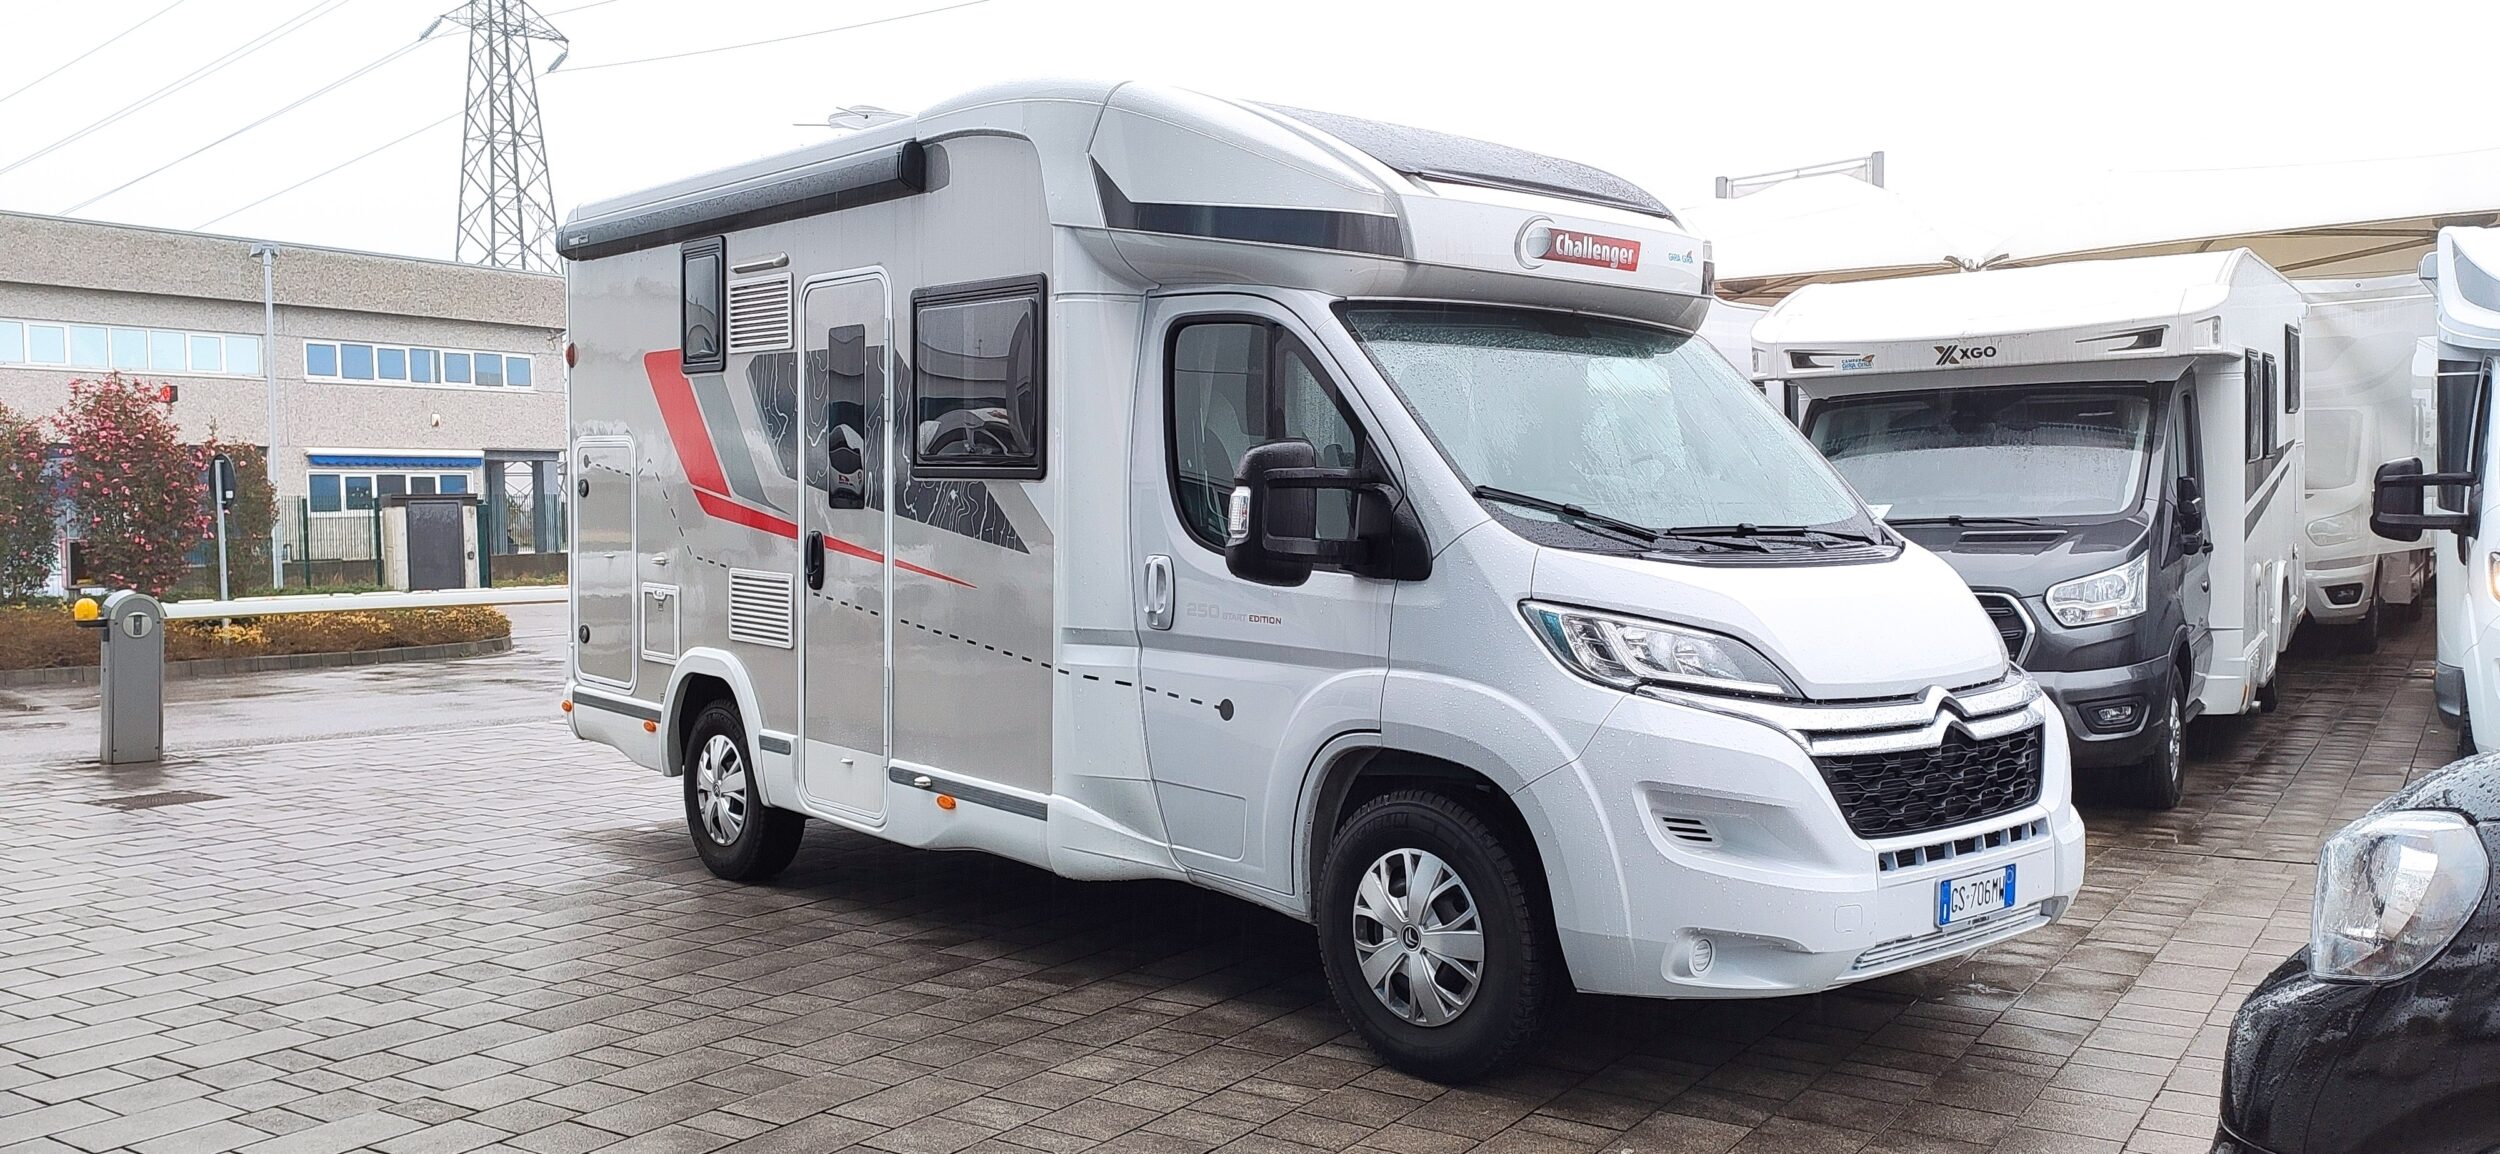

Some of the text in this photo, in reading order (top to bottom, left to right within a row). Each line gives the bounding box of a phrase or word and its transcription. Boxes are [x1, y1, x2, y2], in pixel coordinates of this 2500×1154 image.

[1555, 233, 1634, 268] Challenger
[1959, 346, 1997, 360] XGO
[1186, 602, 1220, 619] 250
[1248, 614, 1282, 625] EDITION
